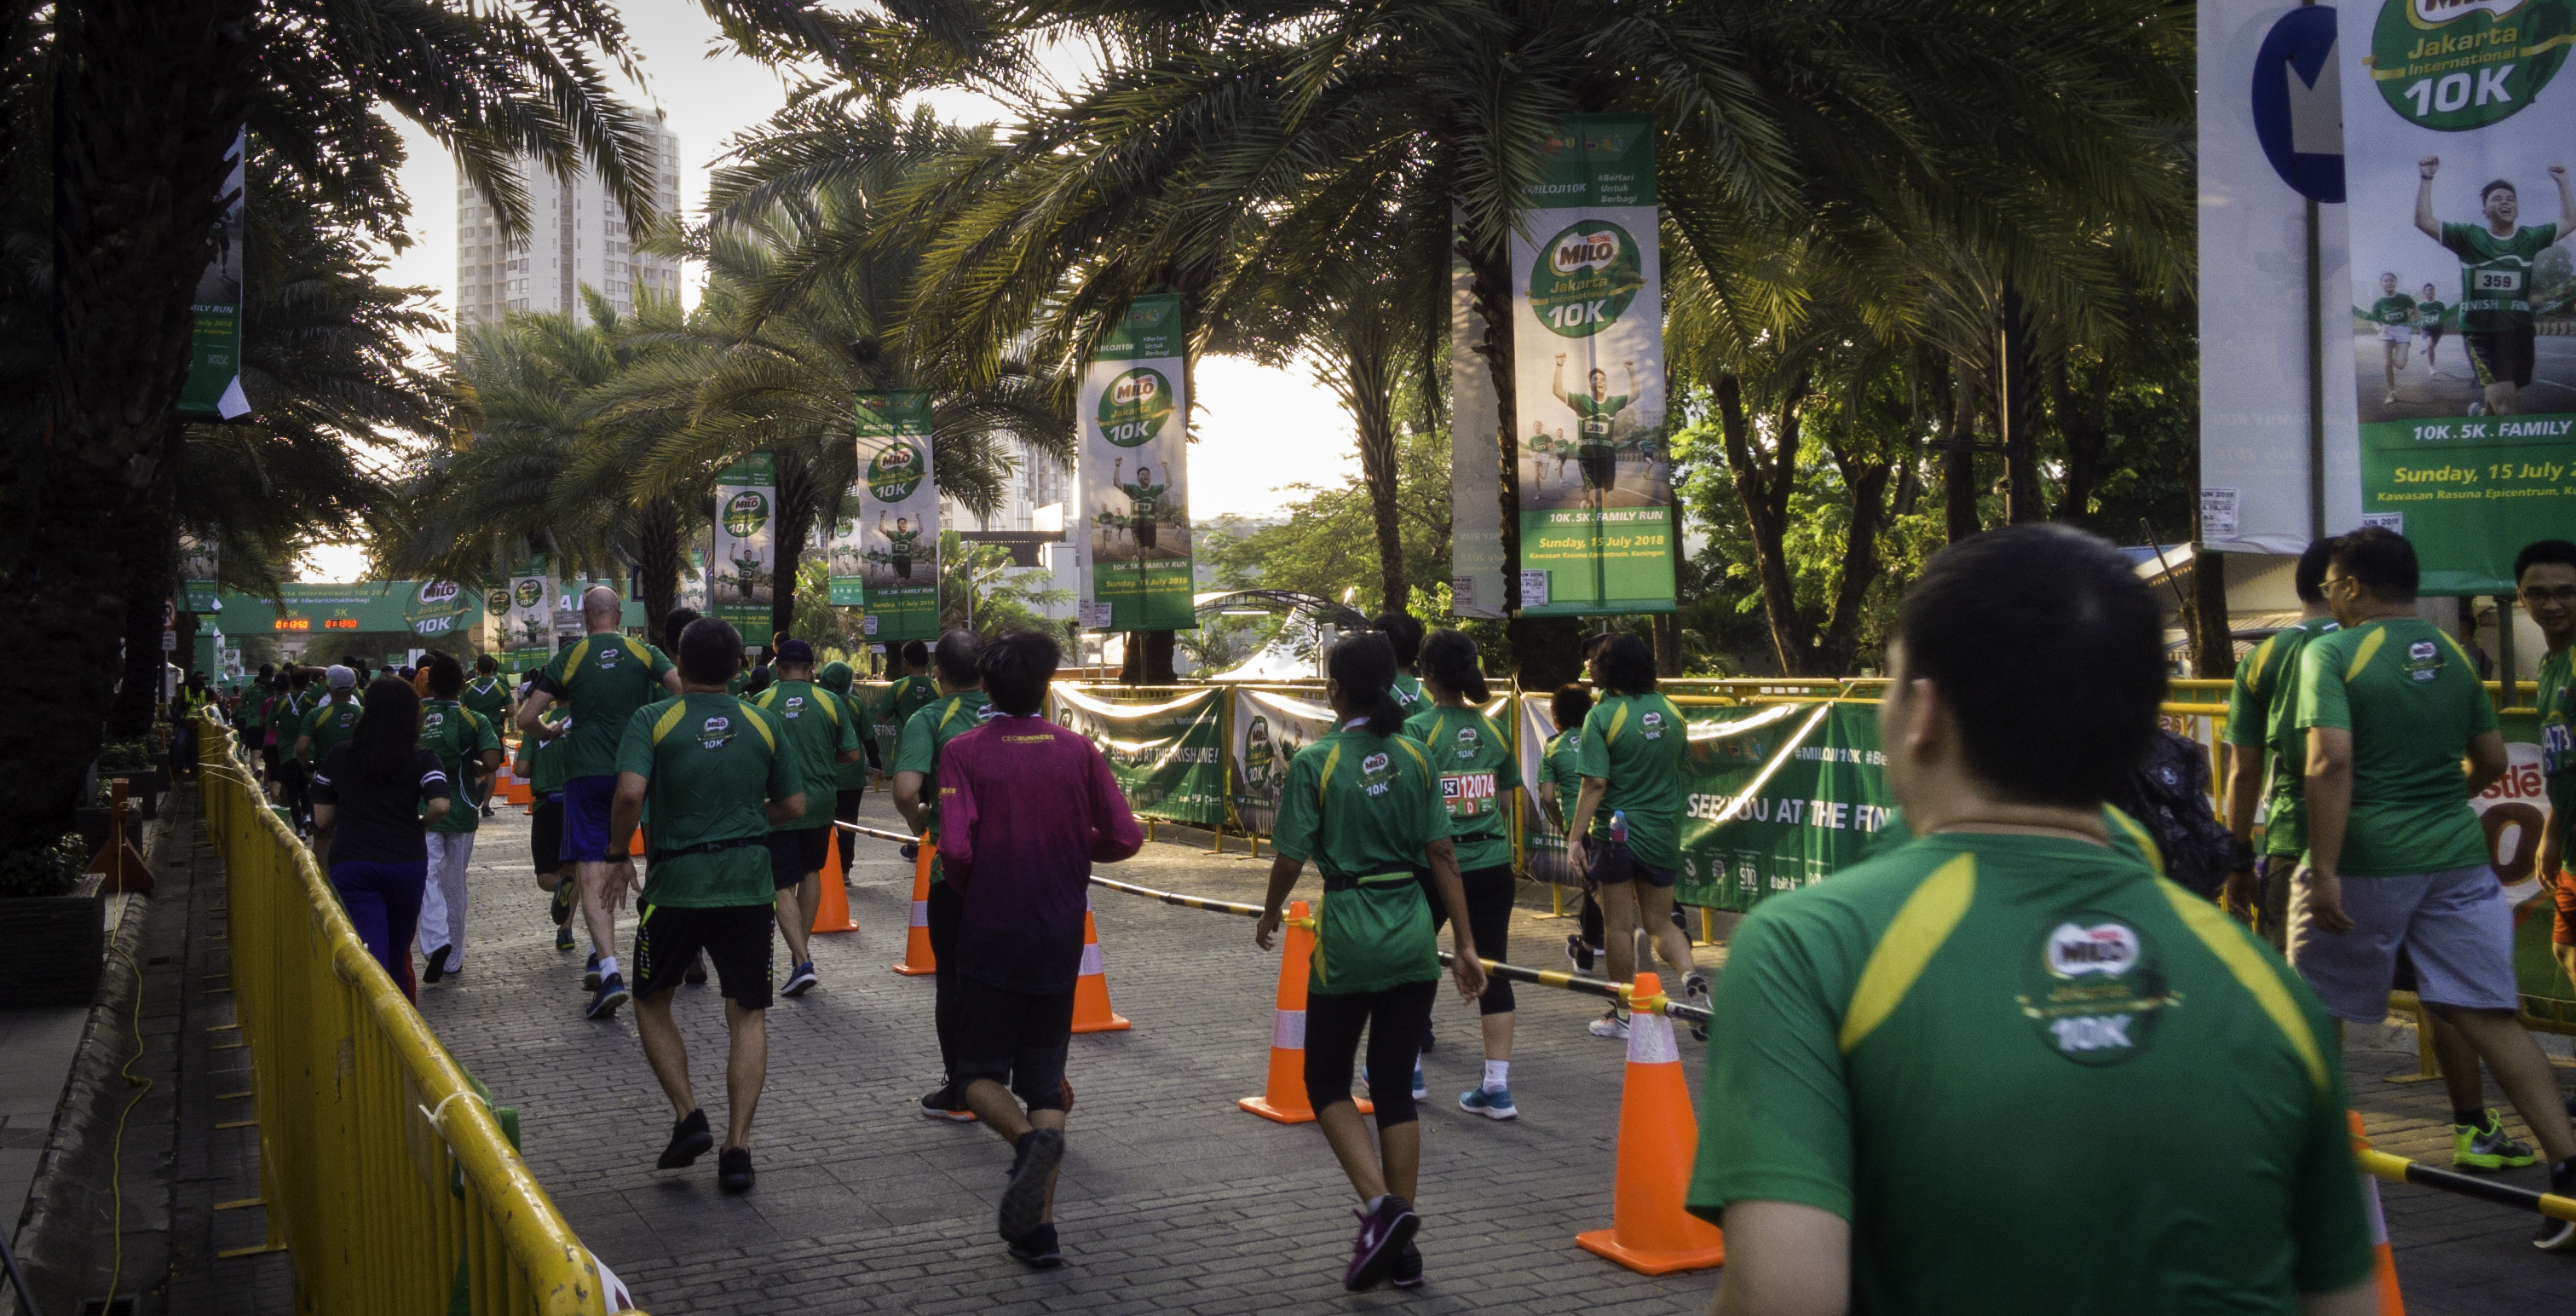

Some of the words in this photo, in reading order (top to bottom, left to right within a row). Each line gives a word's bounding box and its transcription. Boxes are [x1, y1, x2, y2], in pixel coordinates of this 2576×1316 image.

[2408, 26, 2518, 61] Jakarta
[2408, 46, 2517, 76] International
[2404, 65, 2516, 118] 10K
[1601, 184, 1629, 193] Untuk
[1600, 194, 1638, 204] Berbagi
[1559, 242, 1614, 266] MILO
[1550, 277, 1609, 294] Jakarta
[2483, 274, 2512, 288] 359
[213, 305, 233, 314] RUN
[2458, 299, 2499, 312] FINISH
[1547, 299, 1607, 329] 10K
[1116, 382, 1155, 400] MILO
[1109, 420, 1150, 442] 10K
[2412, 424, 2450, 441] 10K
[2460, 424, 2487, 440] 5K
[2498, 421, 2573, 437] FAMILY
[882, 454, 911, 467] MILO
[2394, 466, 2479, 486] Sunday,
[2488, 464, 2514, 480] 15
[2518, 462, 2563, 481] July
[876, 482, 908, 499] 10K
[2377, 492, 2434, 502] Kawasan
[2437, 489, 2482, 500] Rasuna
[2486, 488, 2560, 500] Epicentrum,
[735, 499, 758, 509] MILO
[1550, 513, 1570, 522] 10K
[1576, 513, 1591, 522] 5K
[1596, 511, 1636, 522] FAMILY
[1639, 511, 1664, 521] RUN
[729, 522, 755, 534] 10K
[1539, 537, 1586, 550] Sunday,
[1591, 537, 1604, 546] 15
[1606, 535, 1632, 548] July
[1634, 535, 1664, 545] 2018
[423, 585, 456, 599] MILO
[334, 609, 349, 617] 5K
[416, 616, 452, 634] 10K
[706, 720, 726, 729] MILO
[1001, 734, 1056, 742] CEORUNNERS
[1252, 730, 1267, 742] MIL
[704, 738, 724, 749] 10K
[1144, 747, 1153, 763] AT
[1457, 750, 1475, 759] 10K
[1365, 758, 1386, 771] MILO
[1248, 765, 1265, 782] 10K
[2481, 762, 2542, 799] stlé
[1365, 781, 1389, 797] 10K
[1460, 774, 1495, 799] 12074
[1467, 801, 1473, 814] D
[1686, 794, 1723, 820] SEE
[1776, 798, 1805, 825] AT
[1810, 800, 1849, 829] THE
[1854, 804, 1892, 833] FIN
